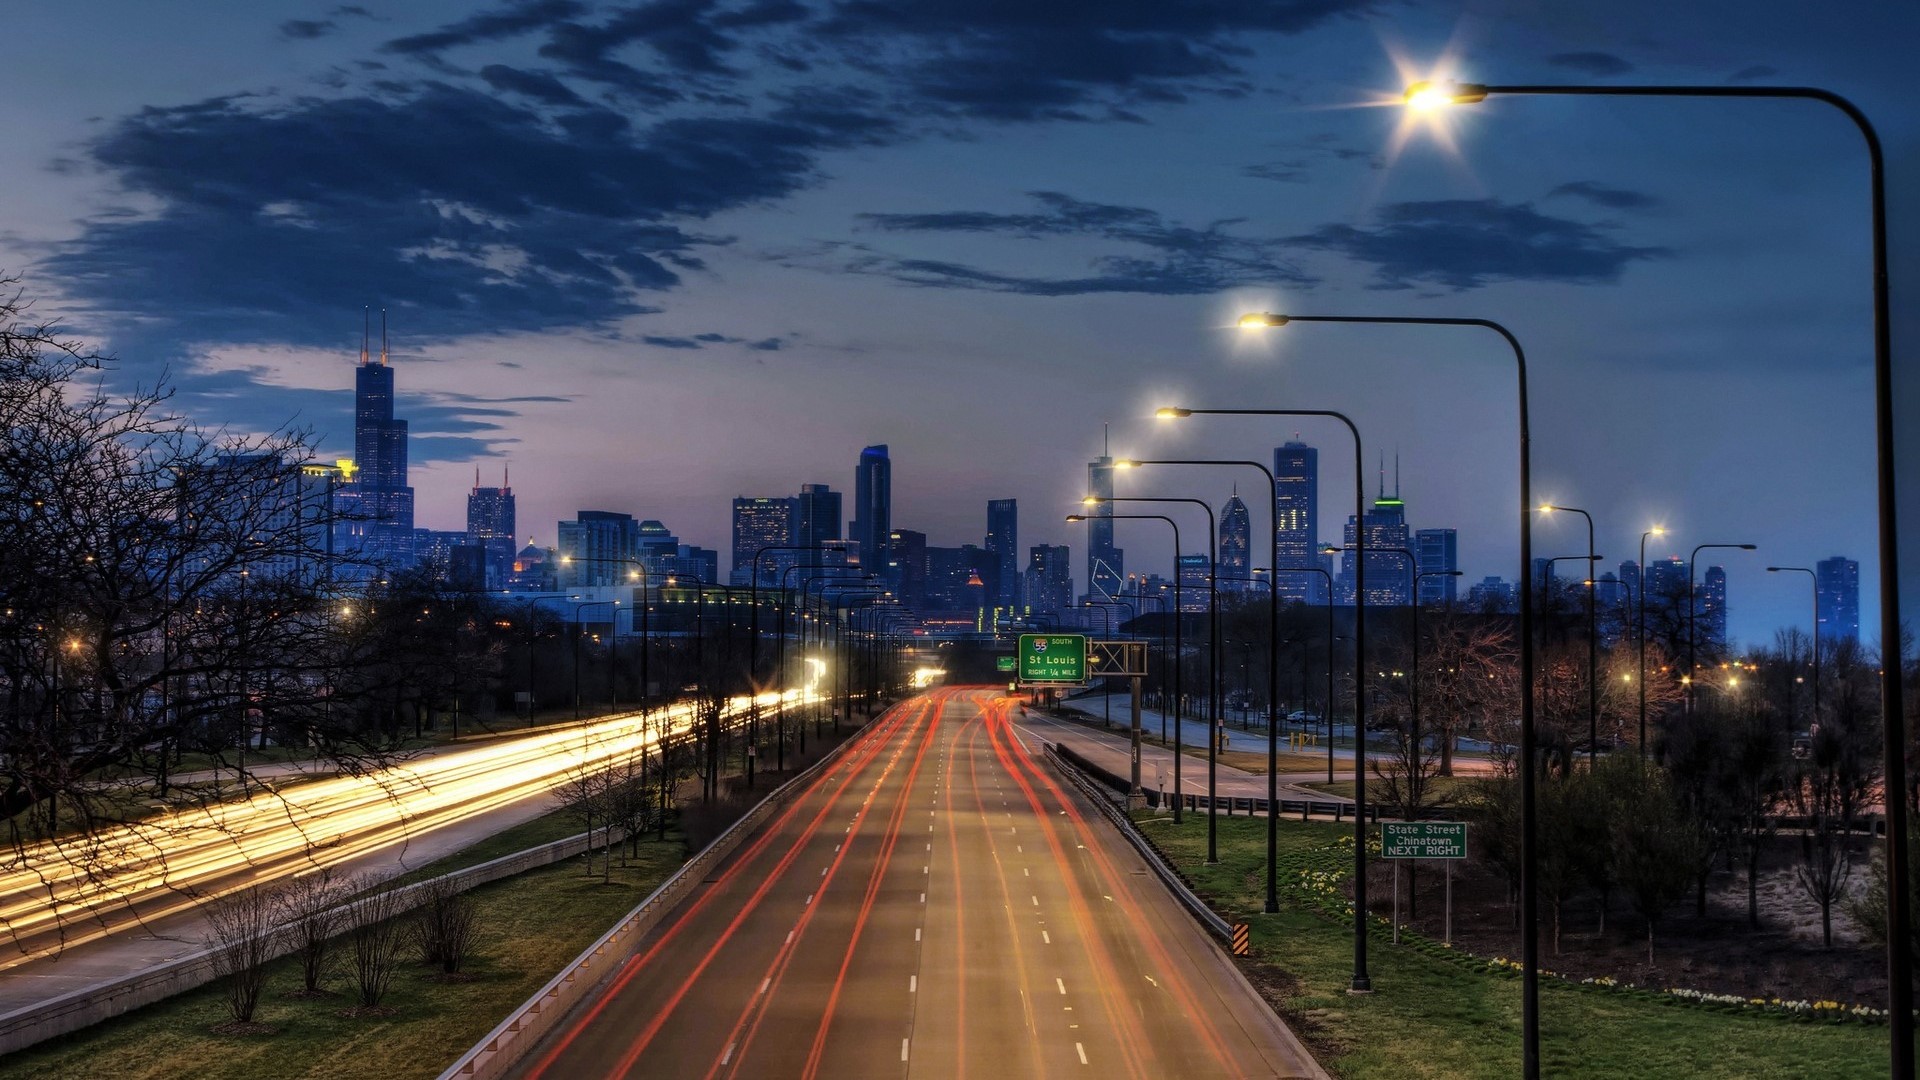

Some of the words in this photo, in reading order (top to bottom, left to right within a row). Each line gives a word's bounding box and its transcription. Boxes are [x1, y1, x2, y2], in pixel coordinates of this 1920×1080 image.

[1035, 642, 1047, 651] 55
[1029, 655, 1041, 664] St
[1046, 655, 1076, 664] Louis
[1388, 825, 1419, 834] State
[1425, 825, 1461, 834] Street
[1396, 836, 1452, 845] Chinatown
[1388, 846, 1419, 855] NEXT
[1426, 846, 1461, 855] RIGHT
